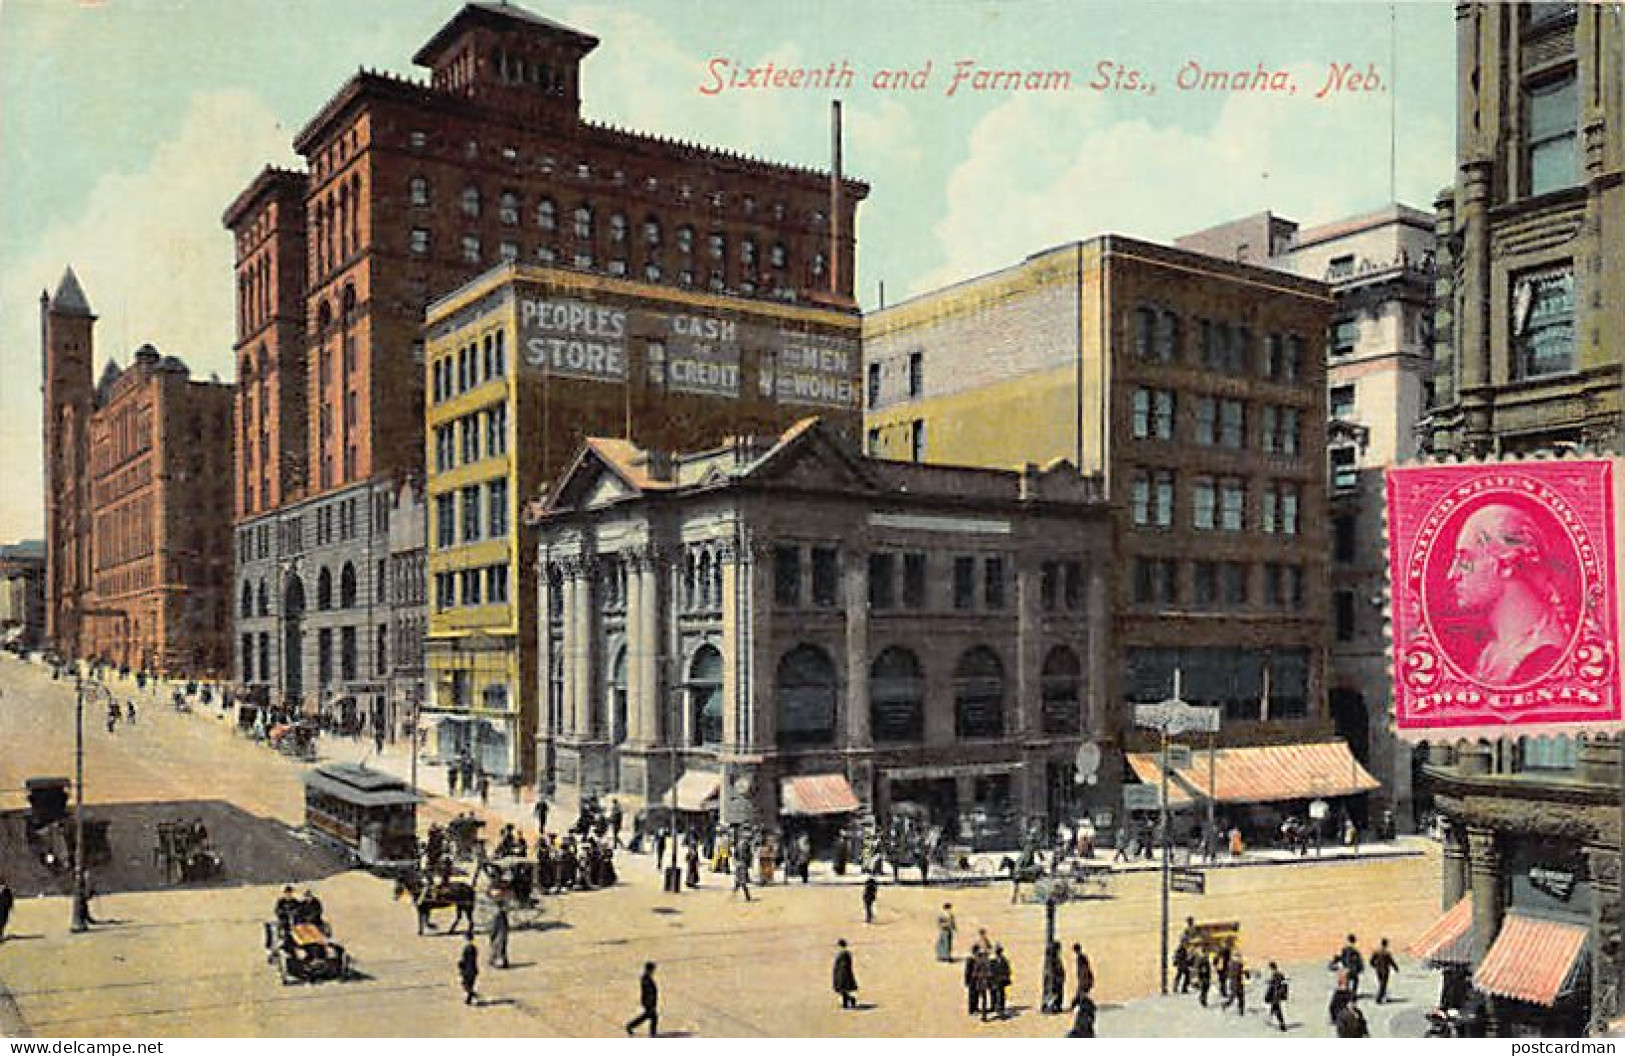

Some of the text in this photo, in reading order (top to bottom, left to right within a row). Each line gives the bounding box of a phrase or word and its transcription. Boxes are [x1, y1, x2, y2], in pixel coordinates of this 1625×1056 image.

[522, 300, 626, 337] PEOPLES
[673, 315, 736, 341] CASH
[526, 337, 623, 373] STORE
[670, 359, 740, 388] CREDIT
[1409, 497, 1456, 579] UNITED
[1407, 653, 1437, 688] 2
[1576, 645, 1605, 683] 2
[1414, 687, 1602, 712] TWO CENTS
